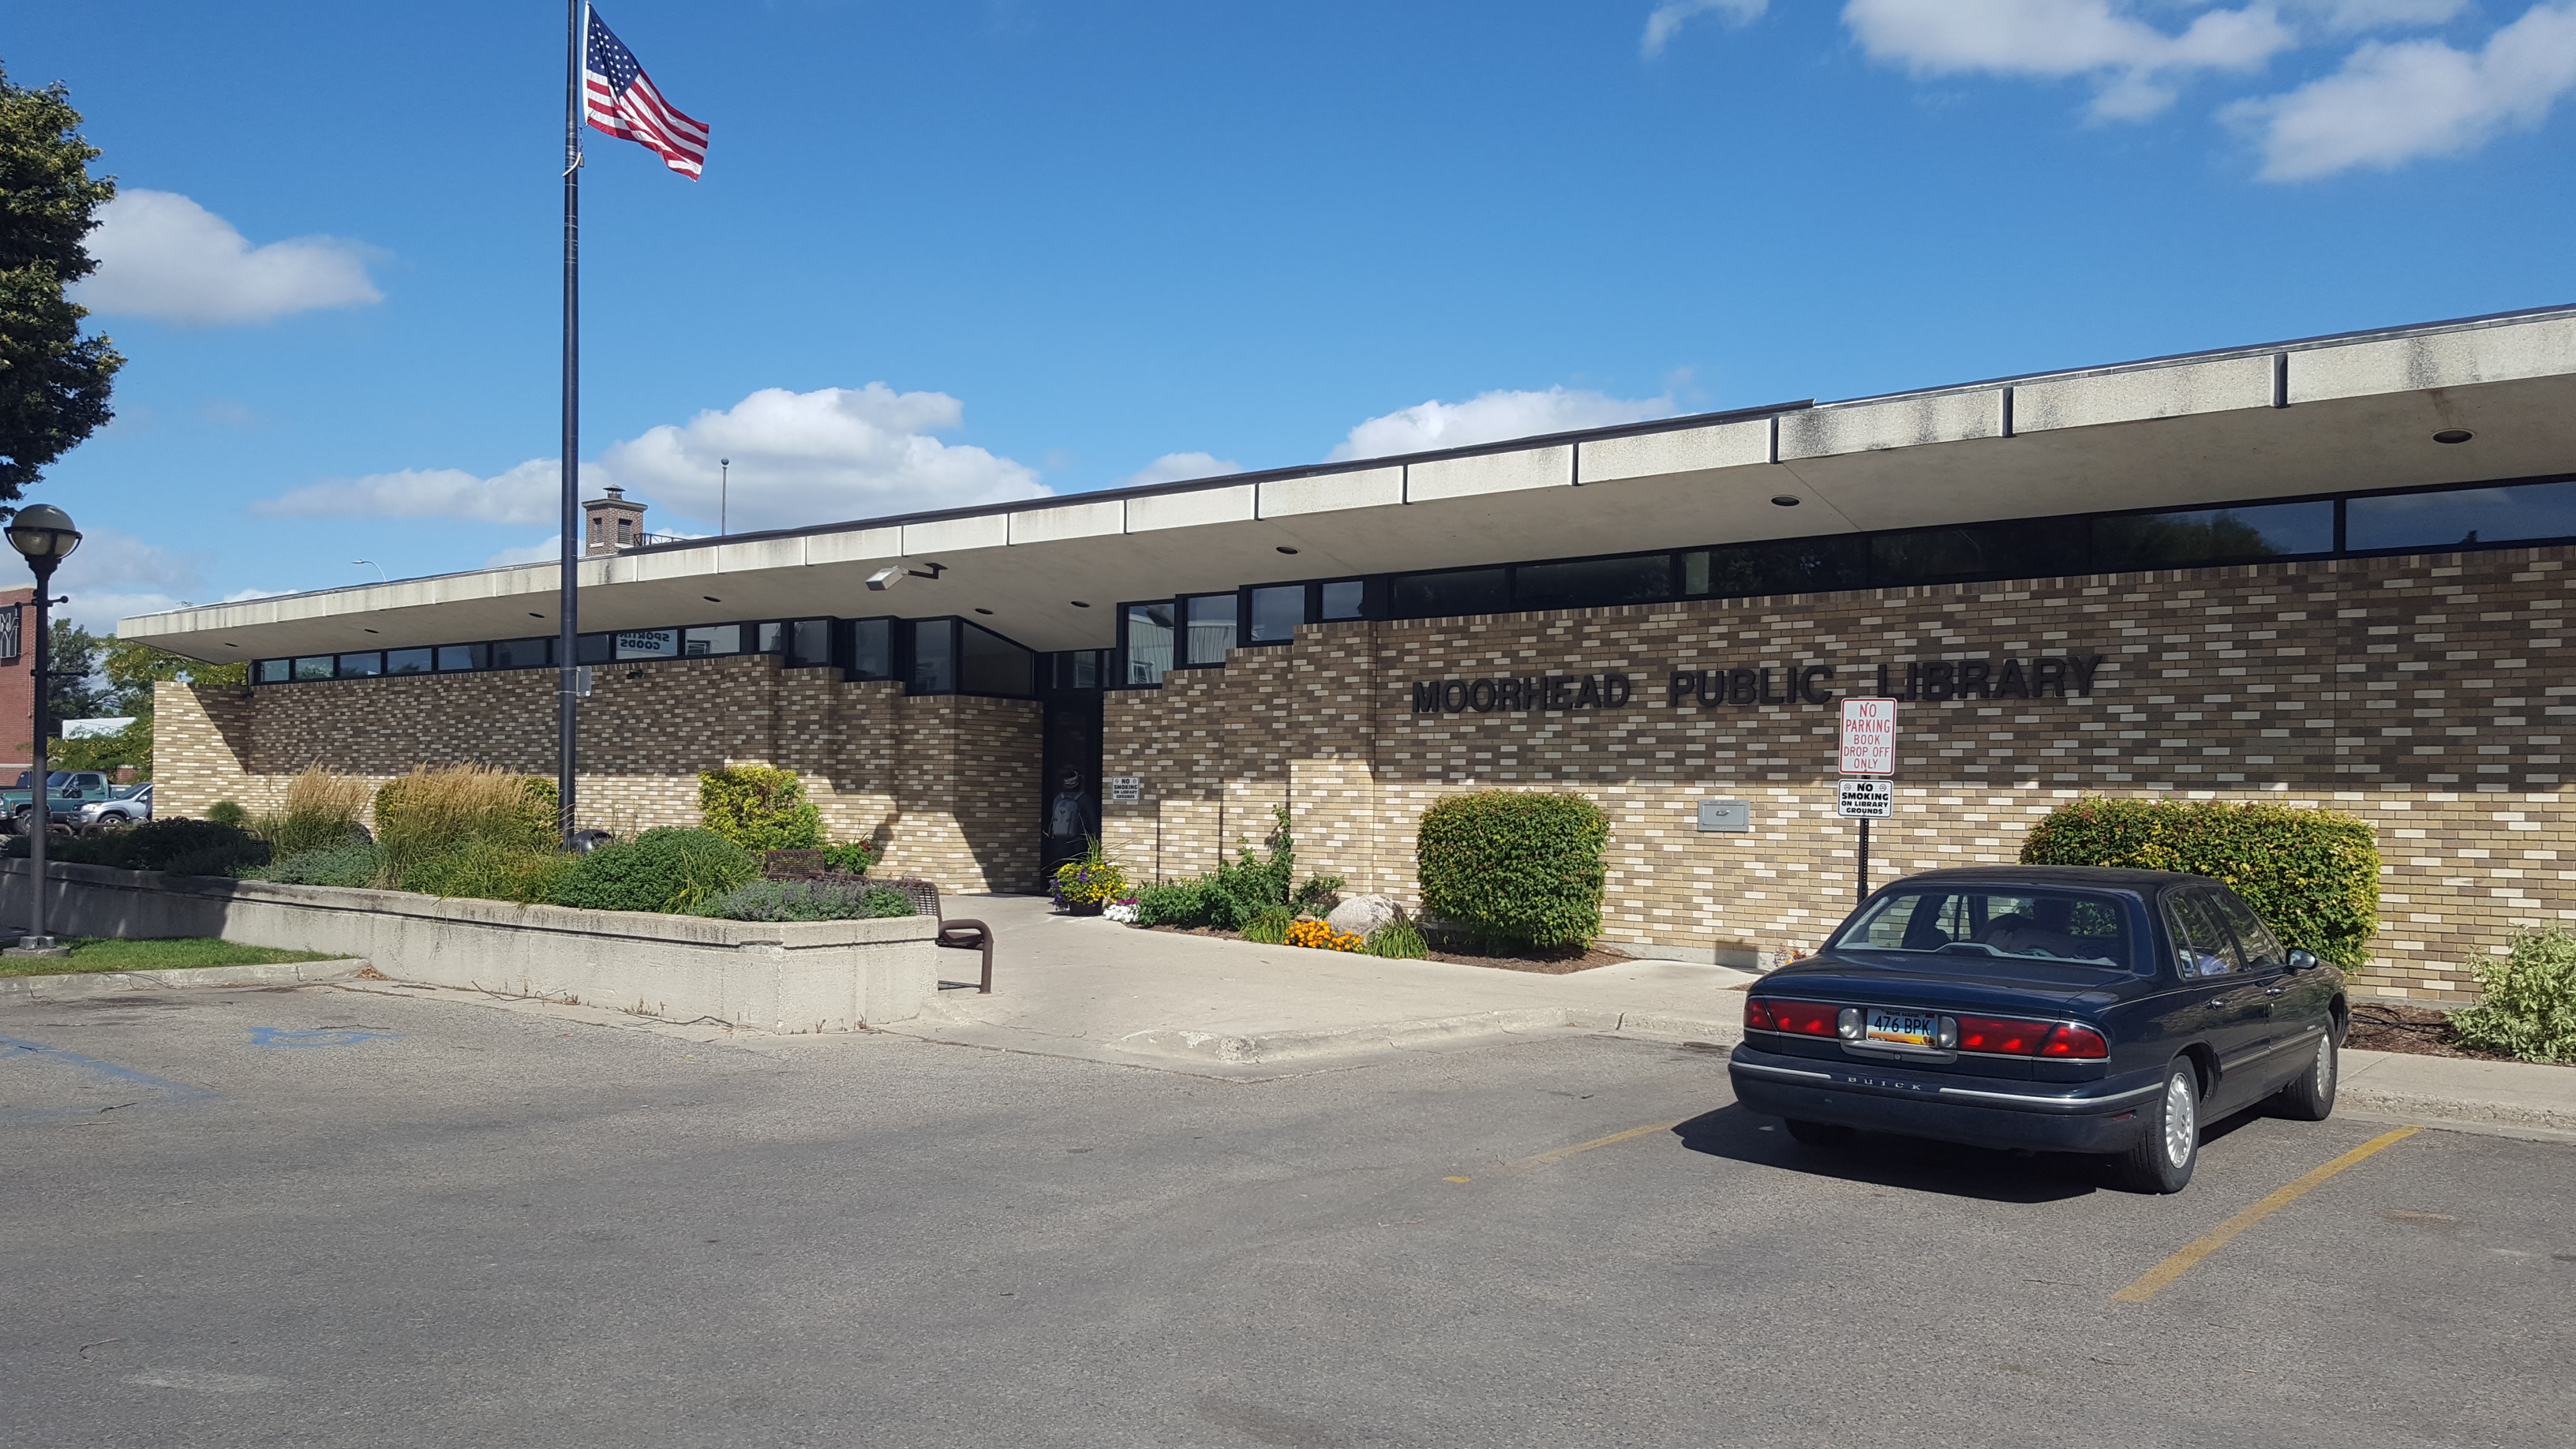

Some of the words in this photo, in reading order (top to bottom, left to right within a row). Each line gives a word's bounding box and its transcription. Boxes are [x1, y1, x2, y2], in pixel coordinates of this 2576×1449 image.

[1412, 673, 1631, 713] MOORHEAD
[1670, 665, 1834, 707] PUBLIC
[1878, 655, 2102, 700] LIBRARY
[1859, 703, 1877, 717] NO
[1845, 719, 1890, 733] PARKING
[1854, 735, 1880, 745] BOOK
[1844, 747, 1869, 757] DROP
[1873, 747, 1890, 757] OFF
[1854, 758, 1878, 769] ONLY
[1841, 792, 1889, 801] SMOKING
[1874, 1015, 1900, 1033] 476
[1904, 1017, 1930, 1036] BPK
[1848, 1076, 1922, 1091] BUICK
